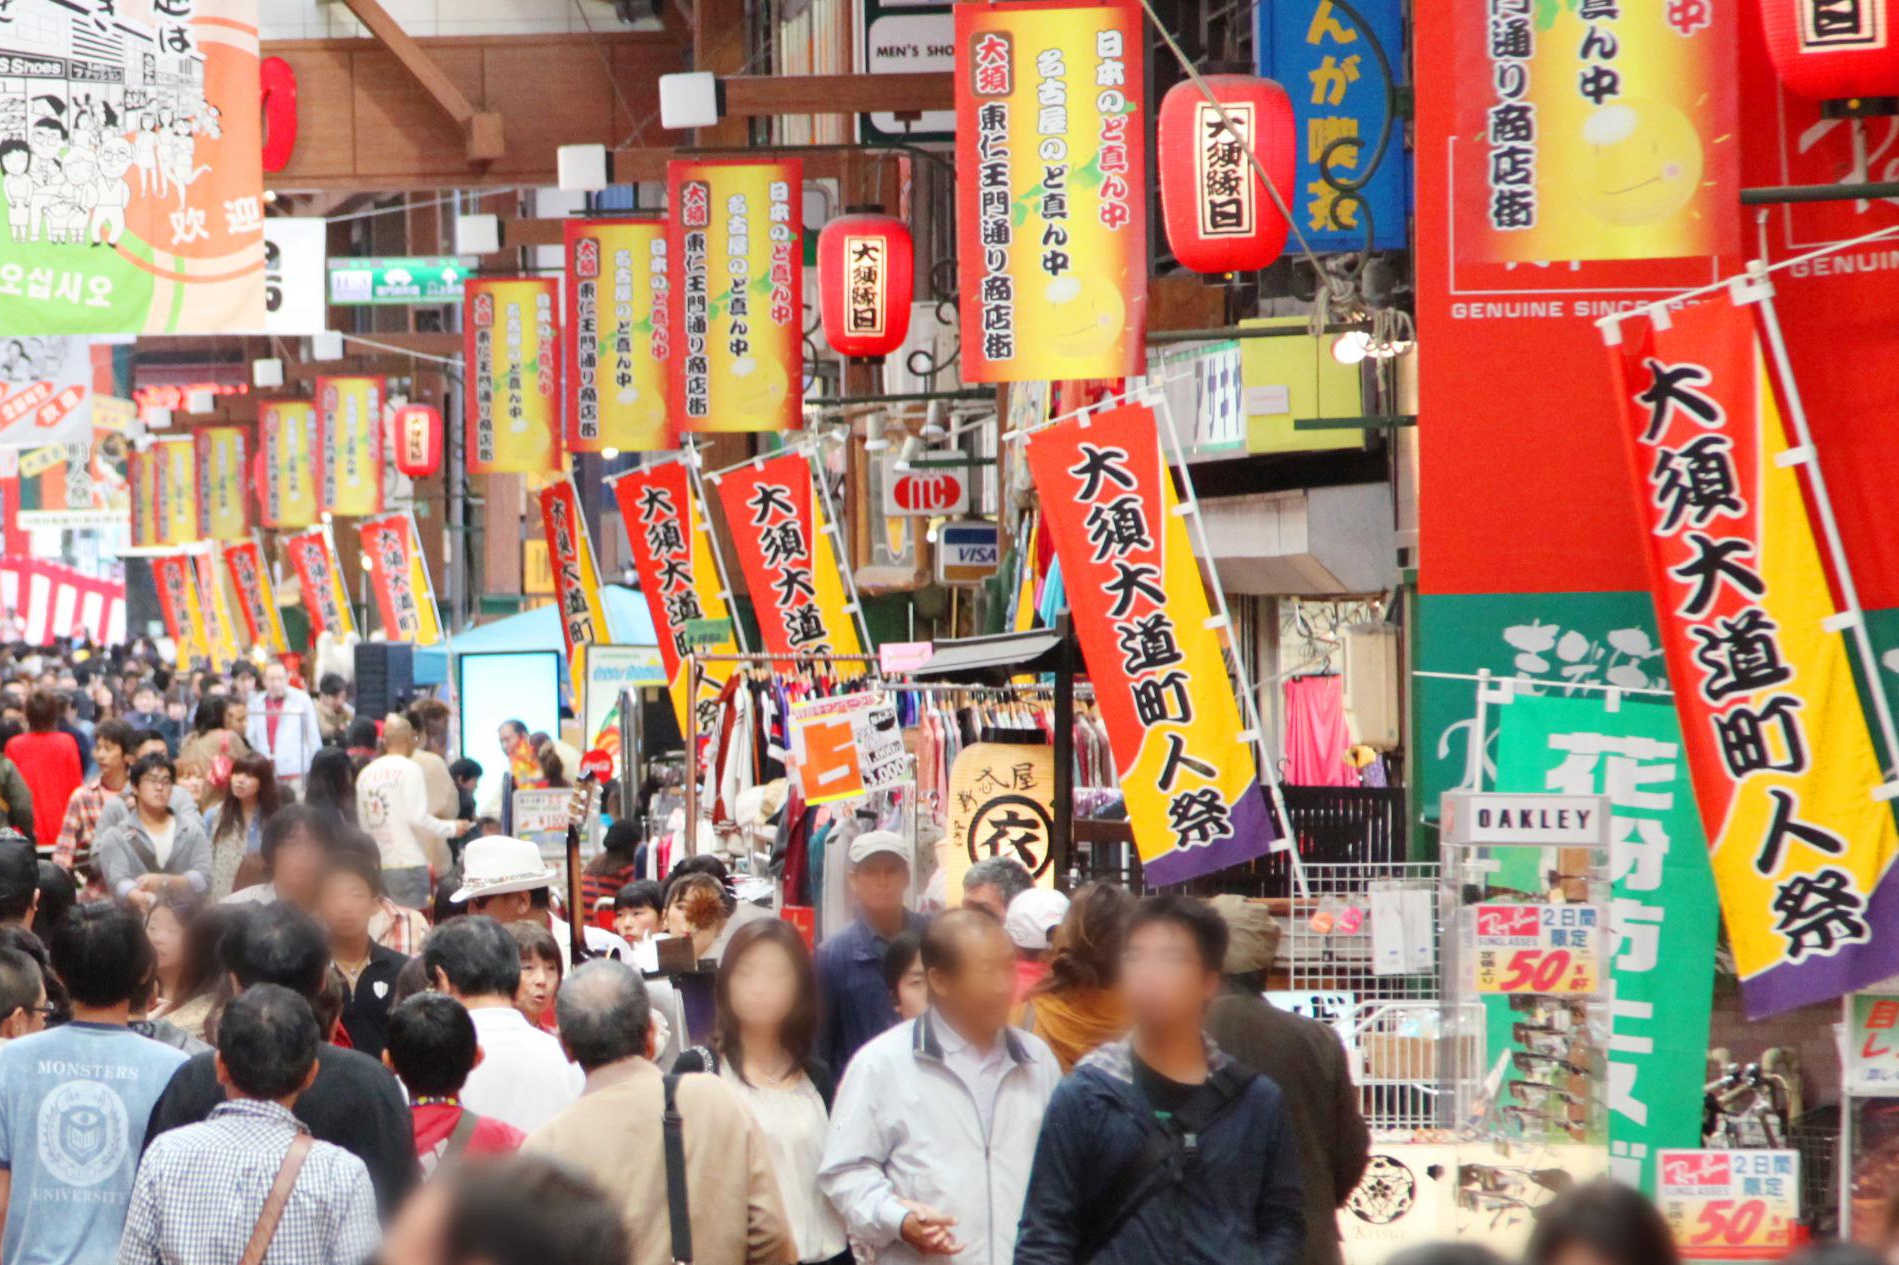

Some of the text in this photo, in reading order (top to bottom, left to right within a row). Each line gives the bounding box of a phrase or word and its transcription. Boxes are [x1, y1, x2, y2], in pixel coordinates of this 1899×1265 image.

[876, 45, 920, 58] MEN'S
[1036, 48, 1070, 276] 名古屋のど真ん中
[1095, 29, 1130, 232] 日本のど真ん中
[977, 35, 1015, 360] 大須 東仁王門通り商店街
[683, 181, 709, 417] 大須 東仁王門通り商店街
[727, 193, 750, 357] 名古屋のど真ん中
[769, 181, 792, 326] 日本のど真ん中
[1451, 302, 1570, 319] GENUINE
[958, 547, 997, 562] VISA
[1070, 442, 1233, 848] 大須大道町人祭
[1634, 357, 1869, 960] 大須大道町人祭
[1477, 808, 1591, 829] OAKLEY
[1543, 908, 1597, 927] 2日間
[1499, 949, 1571, 992] 50
[38, 1060, 139, 1080] MONSTERS
[1689, 1199, 1767, 1245] 50
